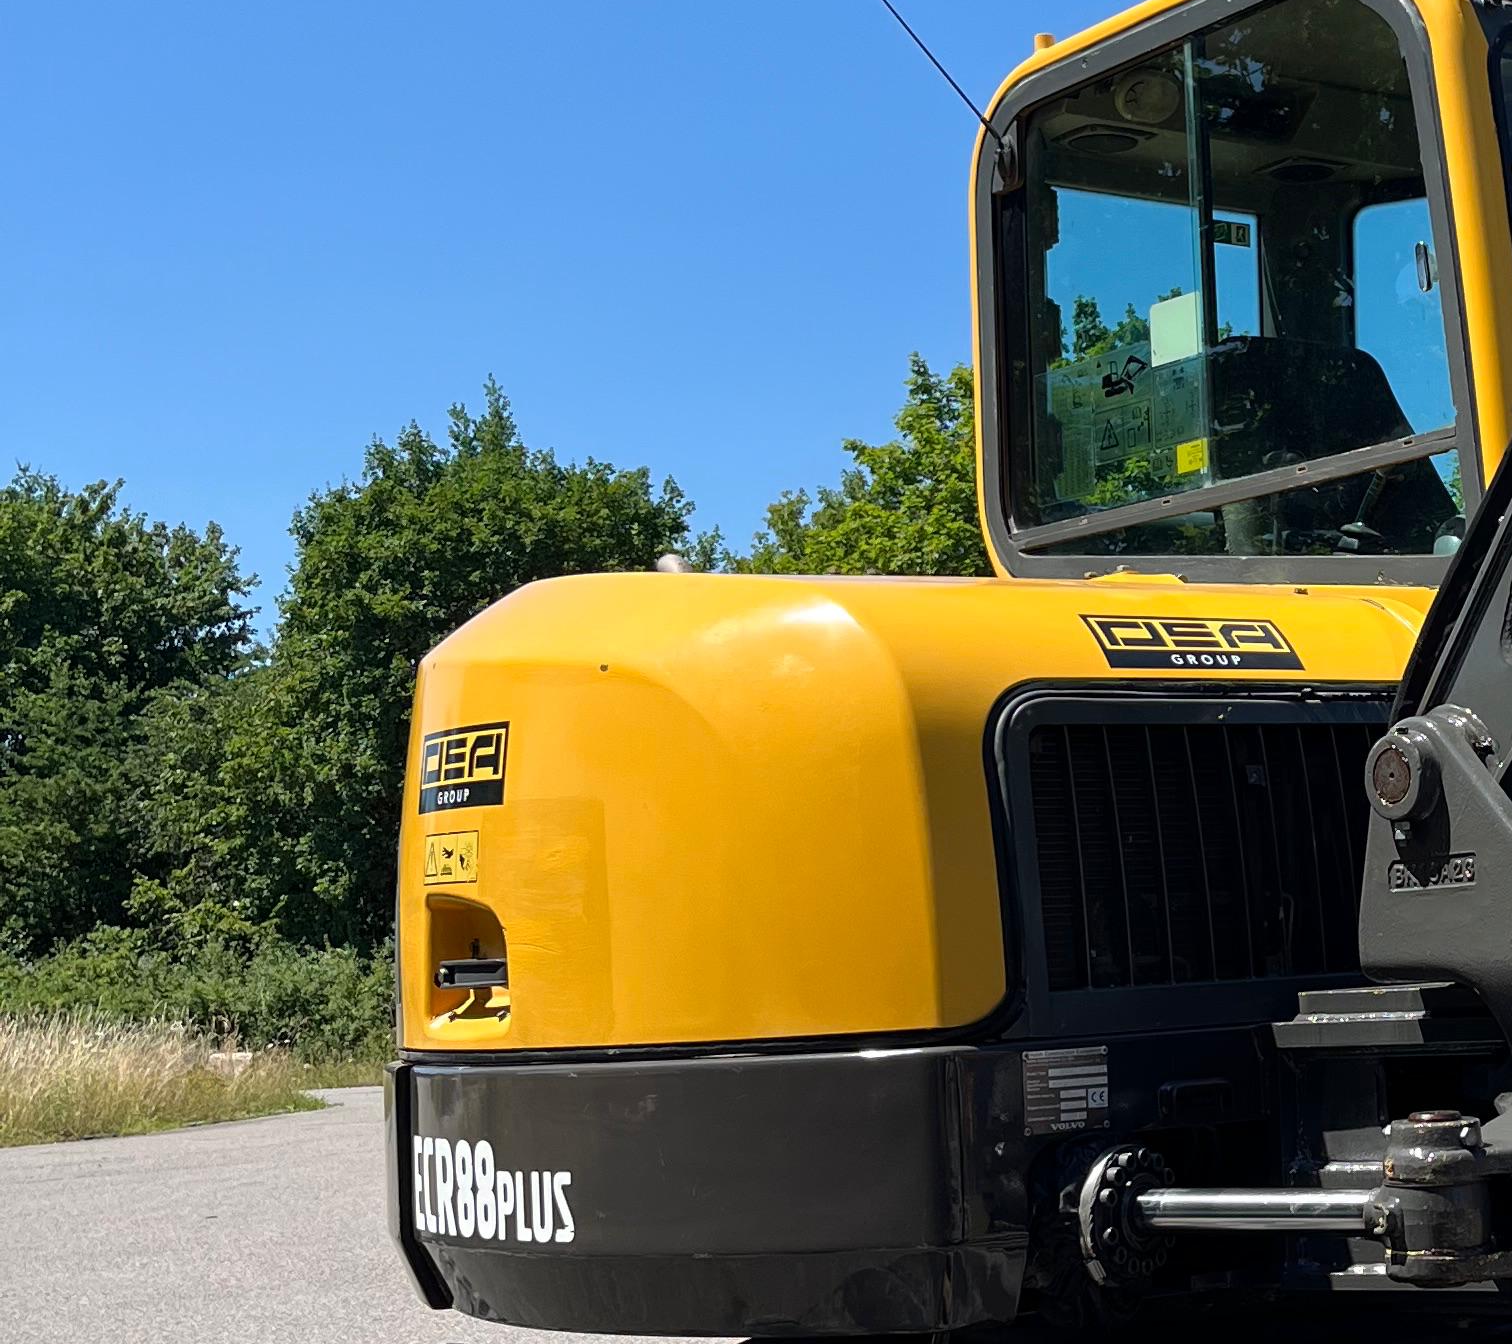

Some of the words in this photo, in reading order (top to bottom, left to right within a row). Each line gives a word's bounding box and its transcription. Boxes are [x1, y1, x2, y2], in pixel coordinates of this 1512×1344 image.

[1170, 653, 1242, 666] GROUP
[437, 788, 471, 805] GROUP
[1050, 1121, 1086, 1131] VOLVO
